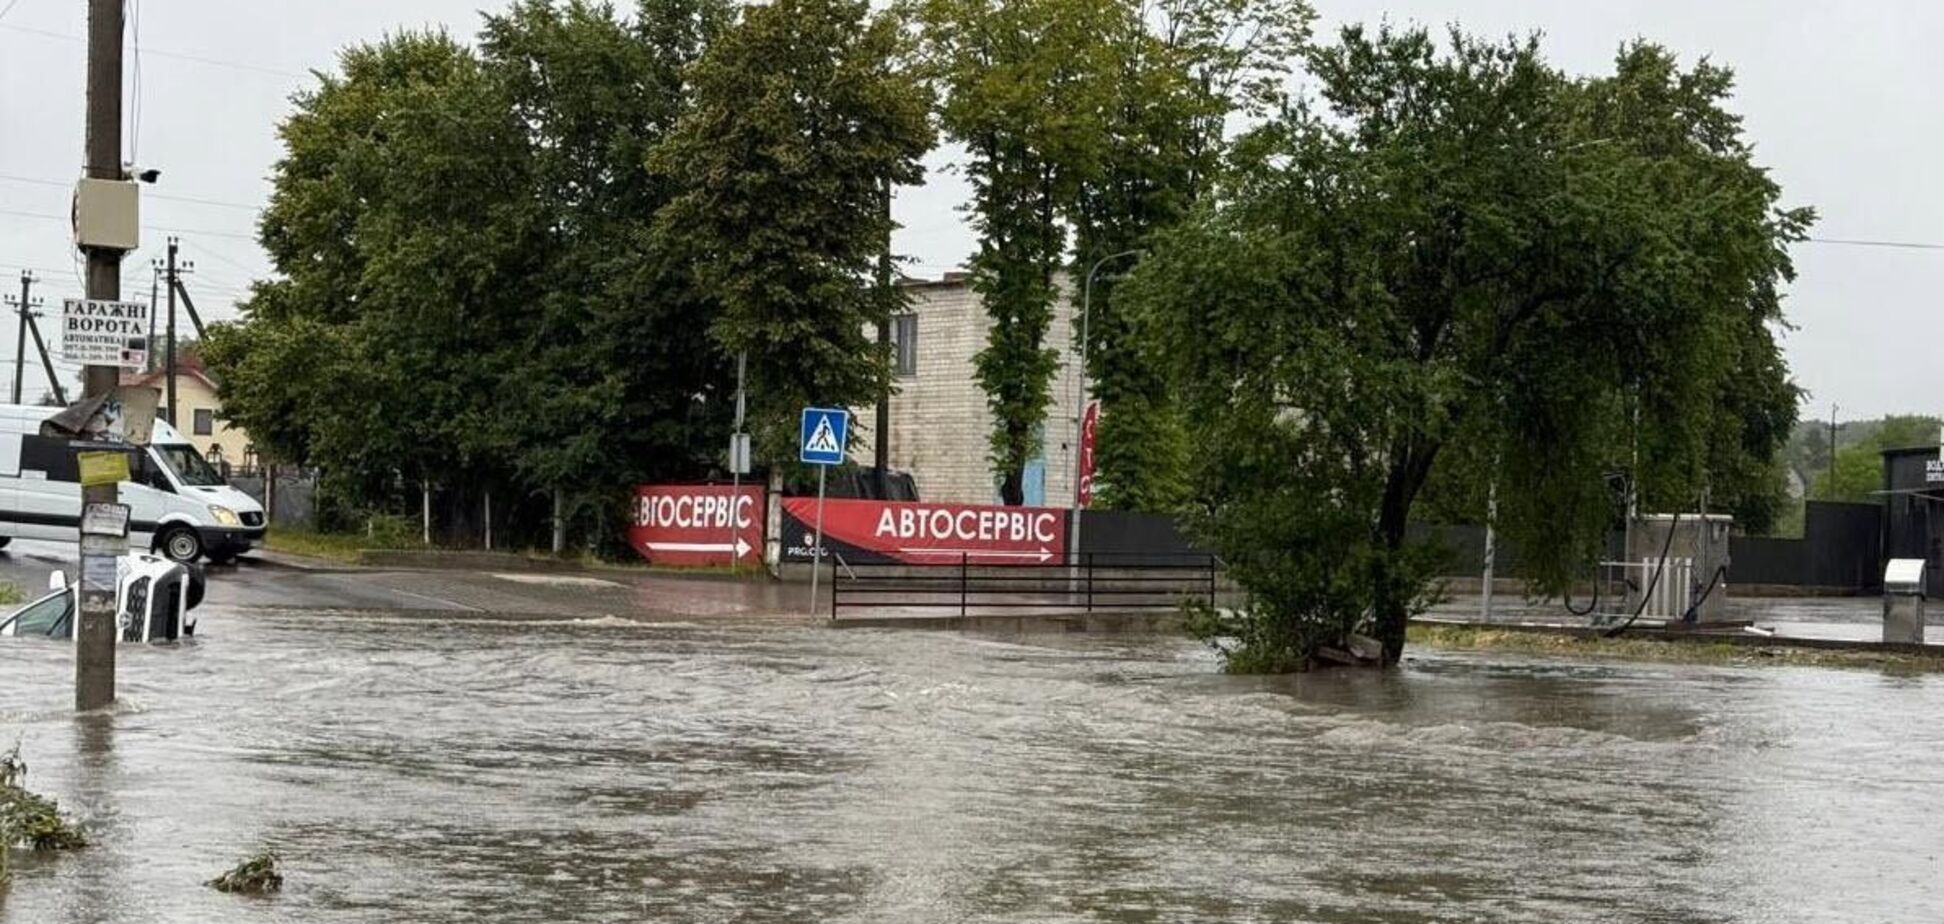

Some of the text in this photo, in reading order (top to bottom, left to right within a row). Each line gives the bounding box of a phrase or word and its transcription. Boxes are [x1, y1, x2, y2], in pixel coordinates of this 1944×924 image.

[64, 301, 147, 319] ГАРАЖНІ
[68, 317, 142, 334] ВОРОТА
[875, 508, 1056, 542] АВТОСЕРВІС
